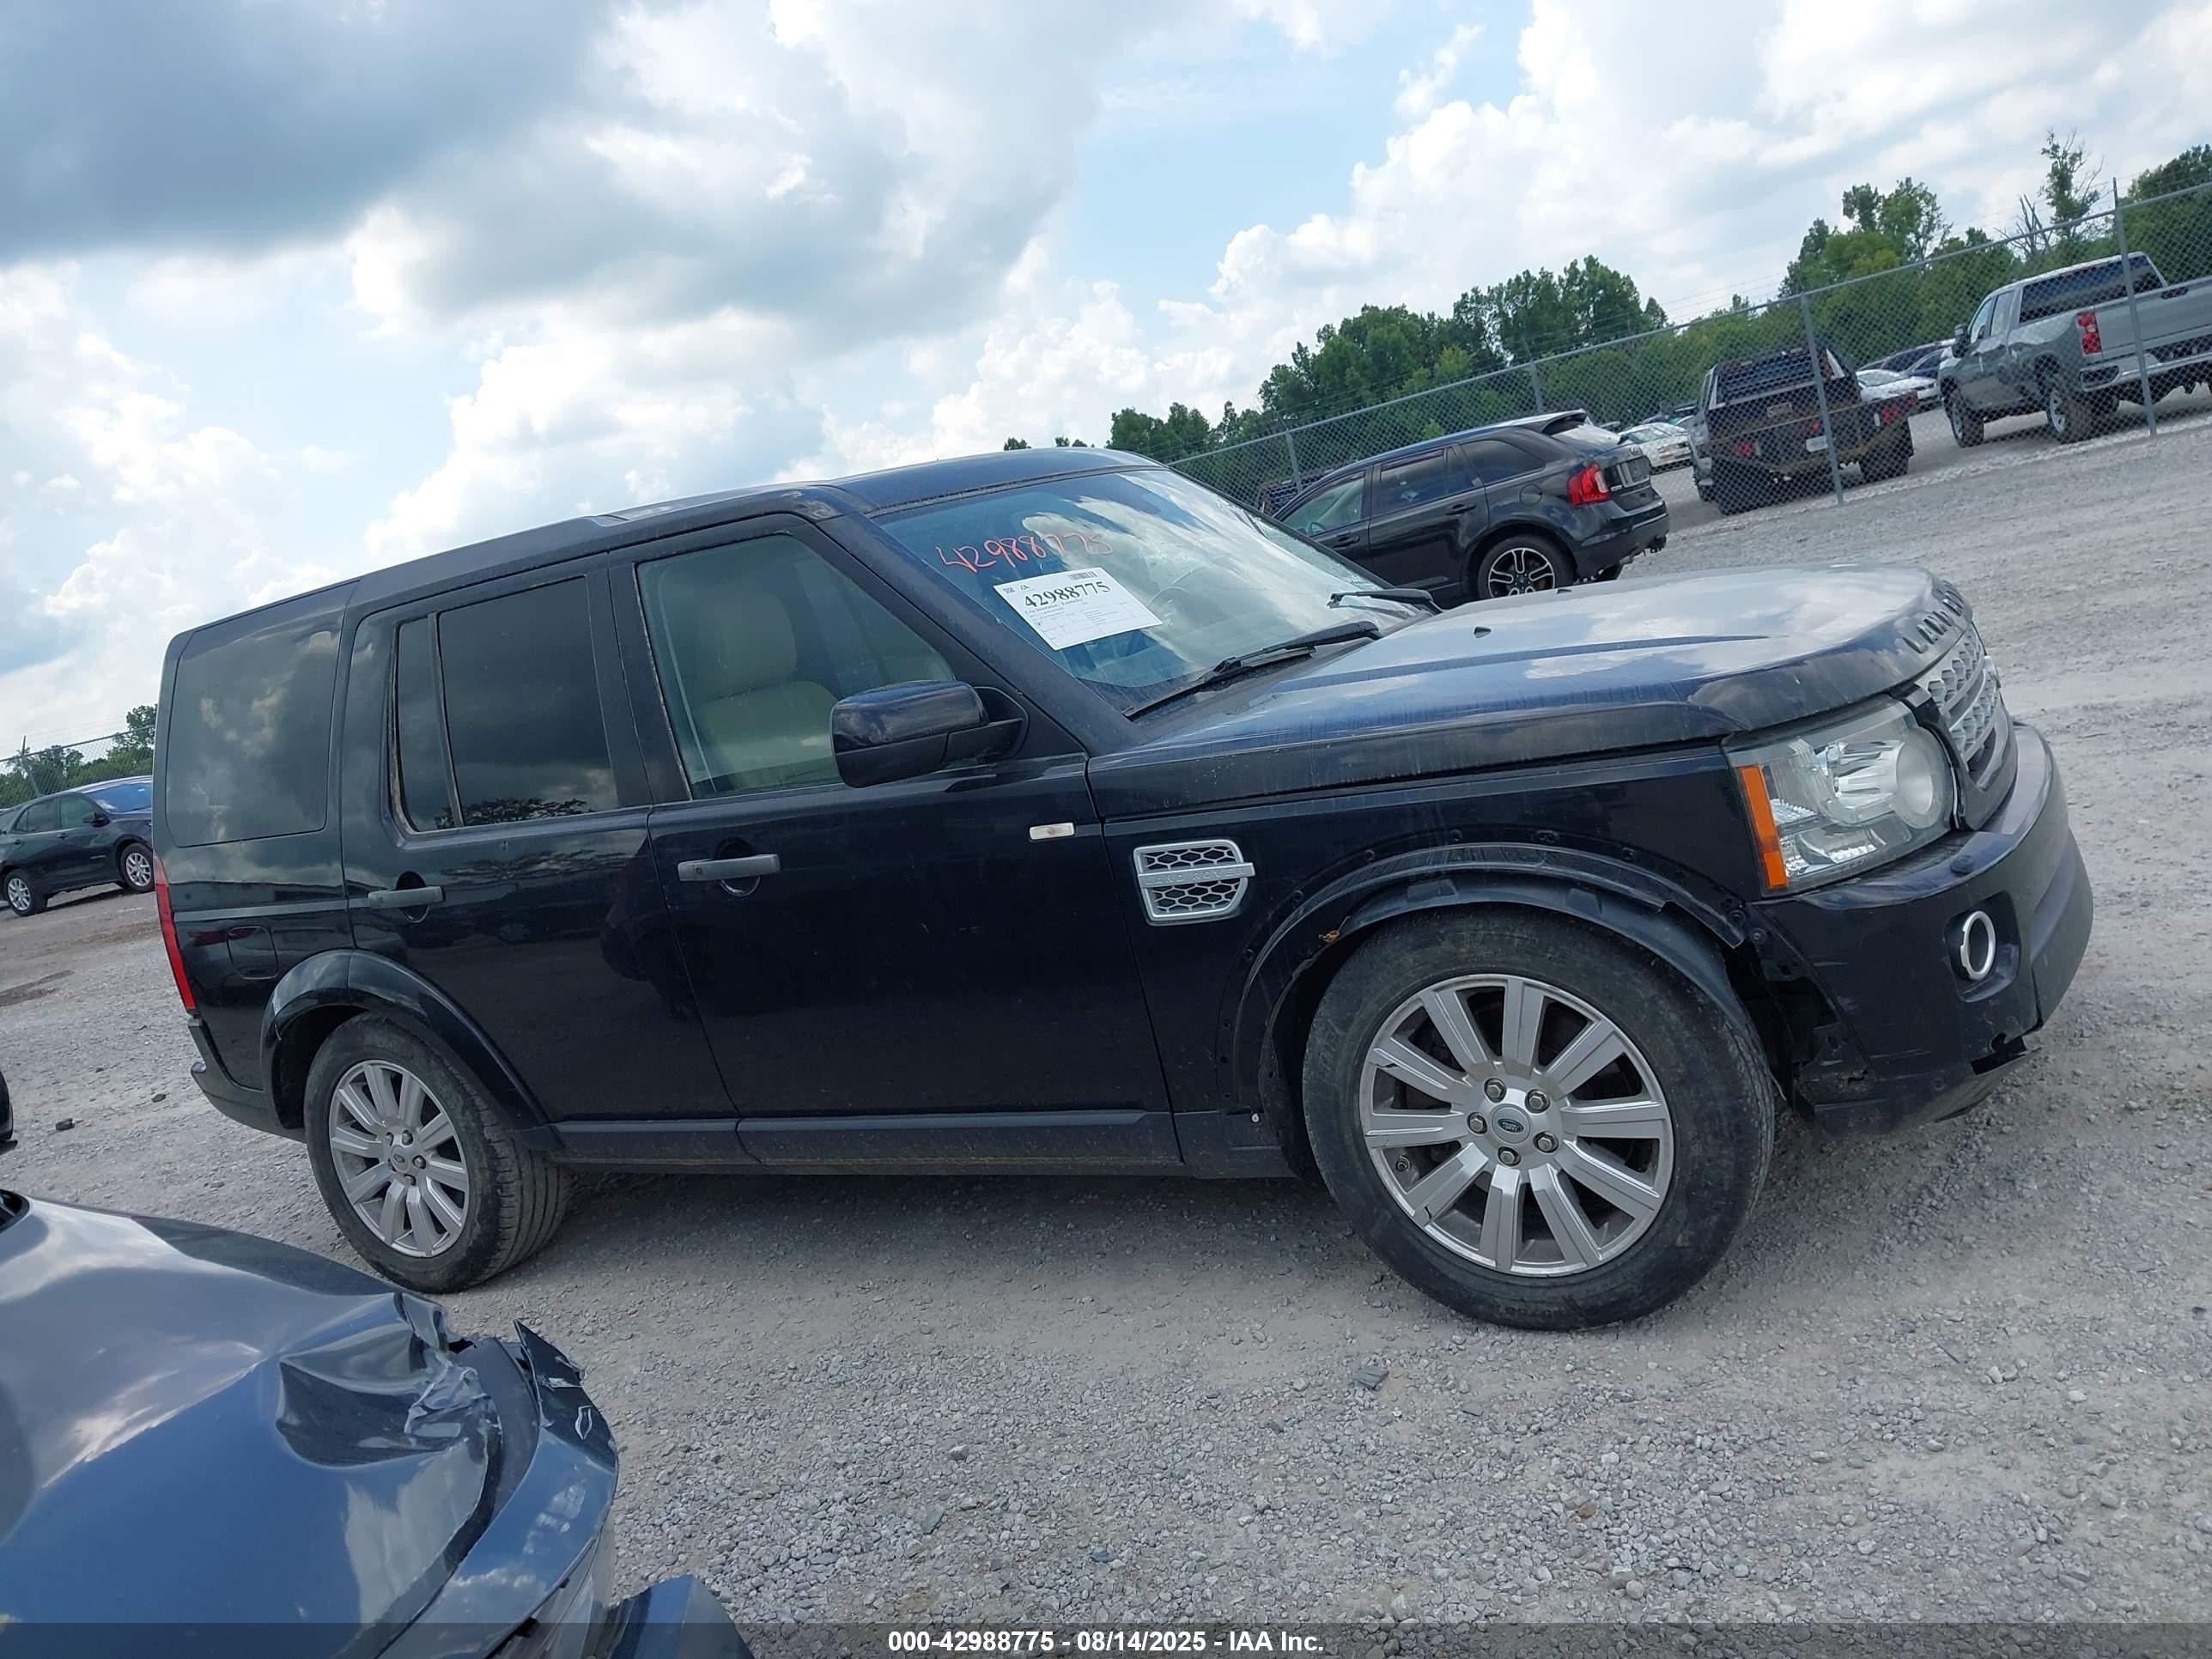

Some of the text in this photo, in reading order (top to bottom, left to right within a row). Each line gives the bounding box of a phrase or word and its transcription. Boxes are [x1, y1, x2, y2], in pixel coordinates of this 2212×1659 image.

[935, 533, 1113, 573] 42988775
[1024, 581, 1110, 607] 42988775
[1193, 867, 1244, 881] ROVER
